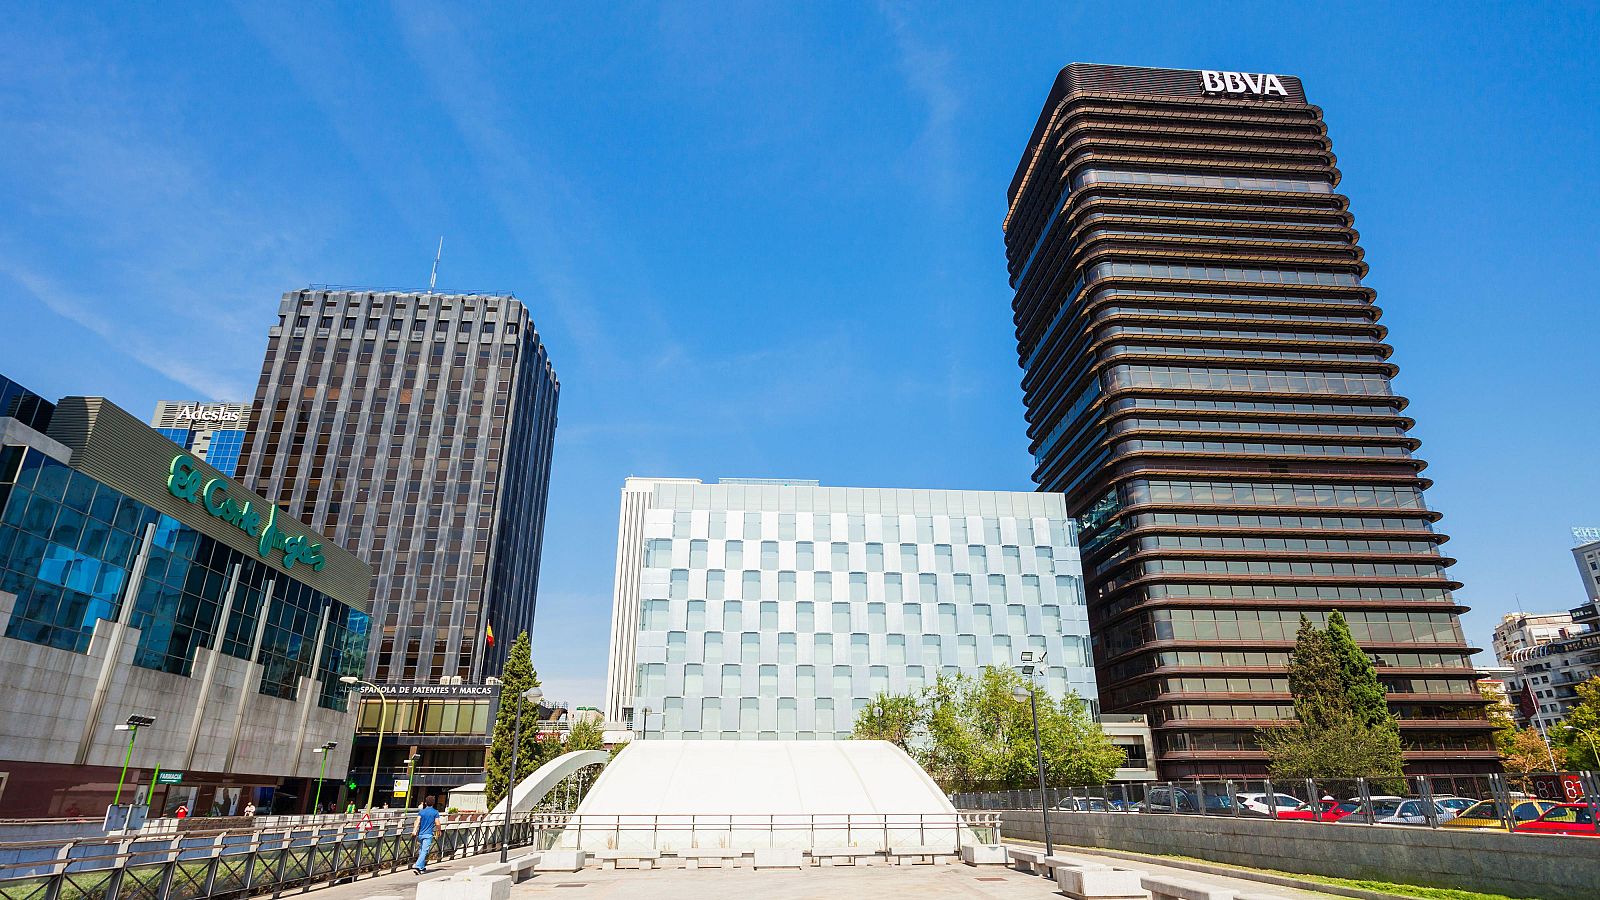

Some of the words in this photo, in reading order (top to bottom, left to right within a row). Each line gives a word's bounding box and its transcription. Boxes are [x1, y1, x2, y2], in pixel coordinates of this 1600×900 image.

[1201, 70, 1288, 95] BBVA
[177, 405, 240, 421] Adeslas
[168, 455, 201, 504] El
[203, 479, 261, 536] Corte
[360, 685, 396, 694] SPAÑOLA
[399, 686, 409, 694] DE
[412, 686, 449, 694] PATENTES
[452, 686, 457, 694] Y
[459, 687, 492, 695] MARCAS
